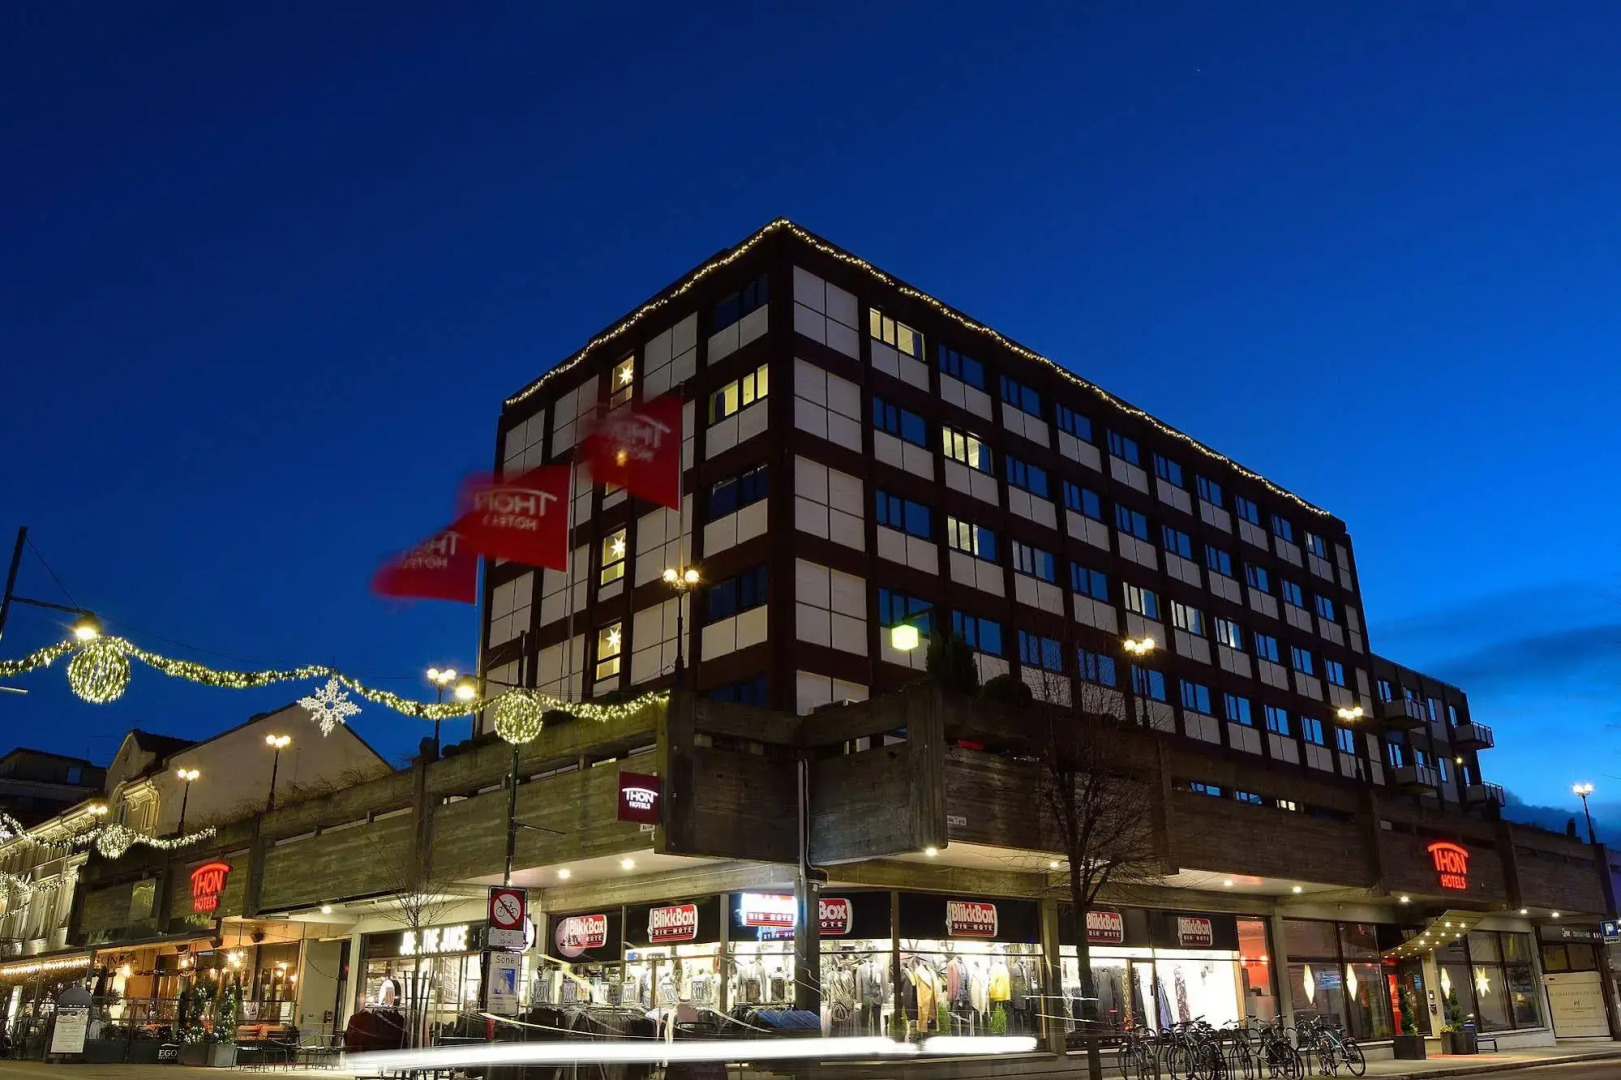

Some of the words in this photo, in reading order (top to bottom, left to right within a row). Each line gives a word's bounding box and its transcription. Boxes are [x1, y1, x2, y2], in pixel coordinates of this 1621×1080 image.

[622, 787, 658, 804] THON
[629, 800, 650, 810] HOTELS
[1428, 842, 1468, 874] THON
[192, 863, 229, 896] THON
[1441, 874, 1466, 889] HOTELS
[194, 895, 218, 912] HOTELS
[1604, 923, 1614, 935] P
[495, 955, 514, 964] Sone
